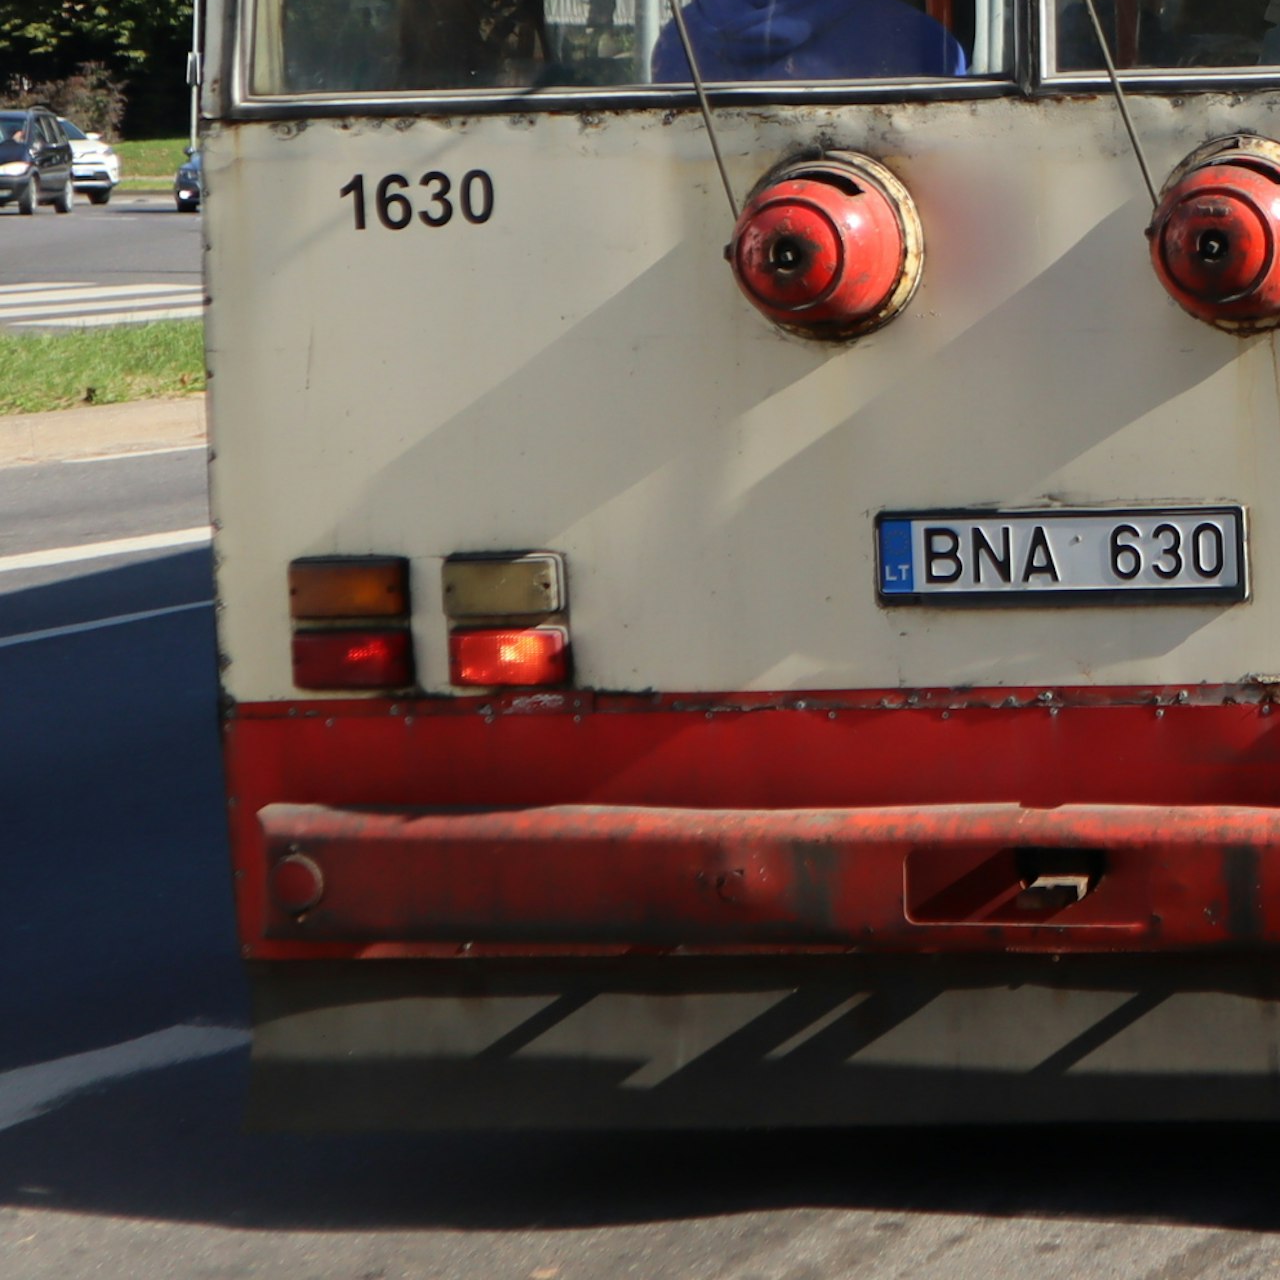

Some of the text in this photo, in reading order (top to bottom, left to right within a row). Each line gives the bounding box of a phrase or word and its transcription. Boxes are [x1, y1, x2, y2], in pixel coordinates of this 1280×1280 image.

[339, 169, 494, 230] 1630
[884, 564, 910, 582] LT
[923, 522, 1224, 584] BNA 630
